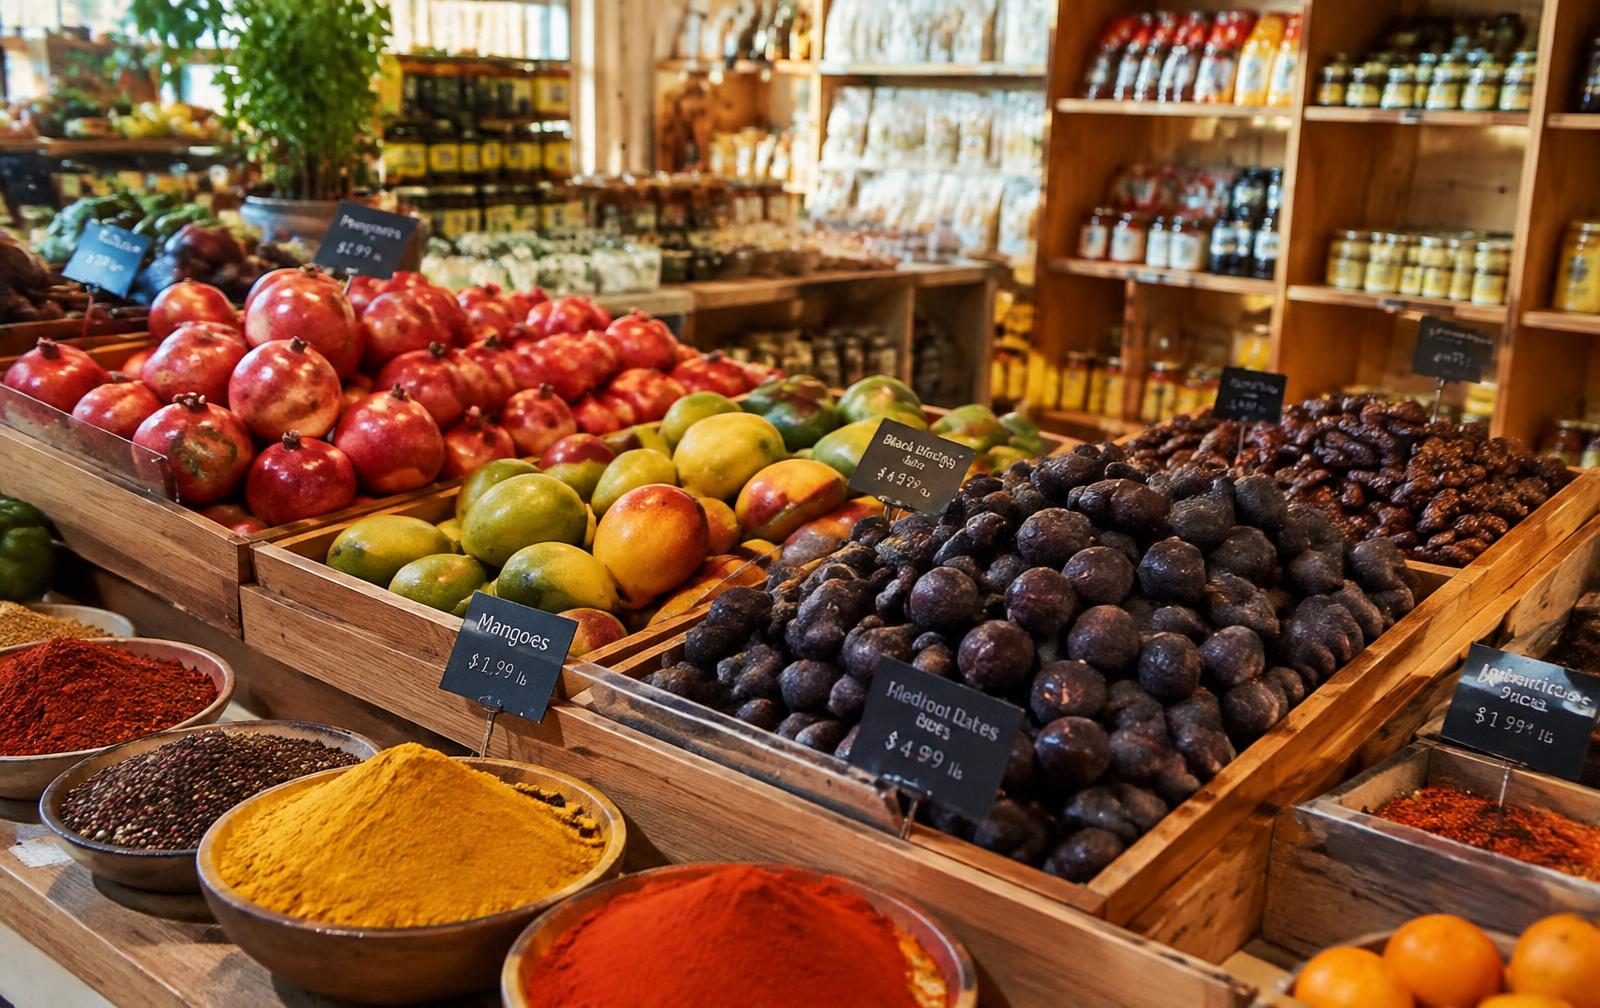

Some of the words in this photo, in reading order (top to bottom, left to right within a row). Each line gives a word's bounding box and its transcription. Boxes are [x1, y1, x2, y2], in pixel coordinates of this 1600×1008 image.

[476, 612, 550, 651] Mangoes
[515, 670, 527, 686] lb
[952, 708, 1000, 742] Dates
